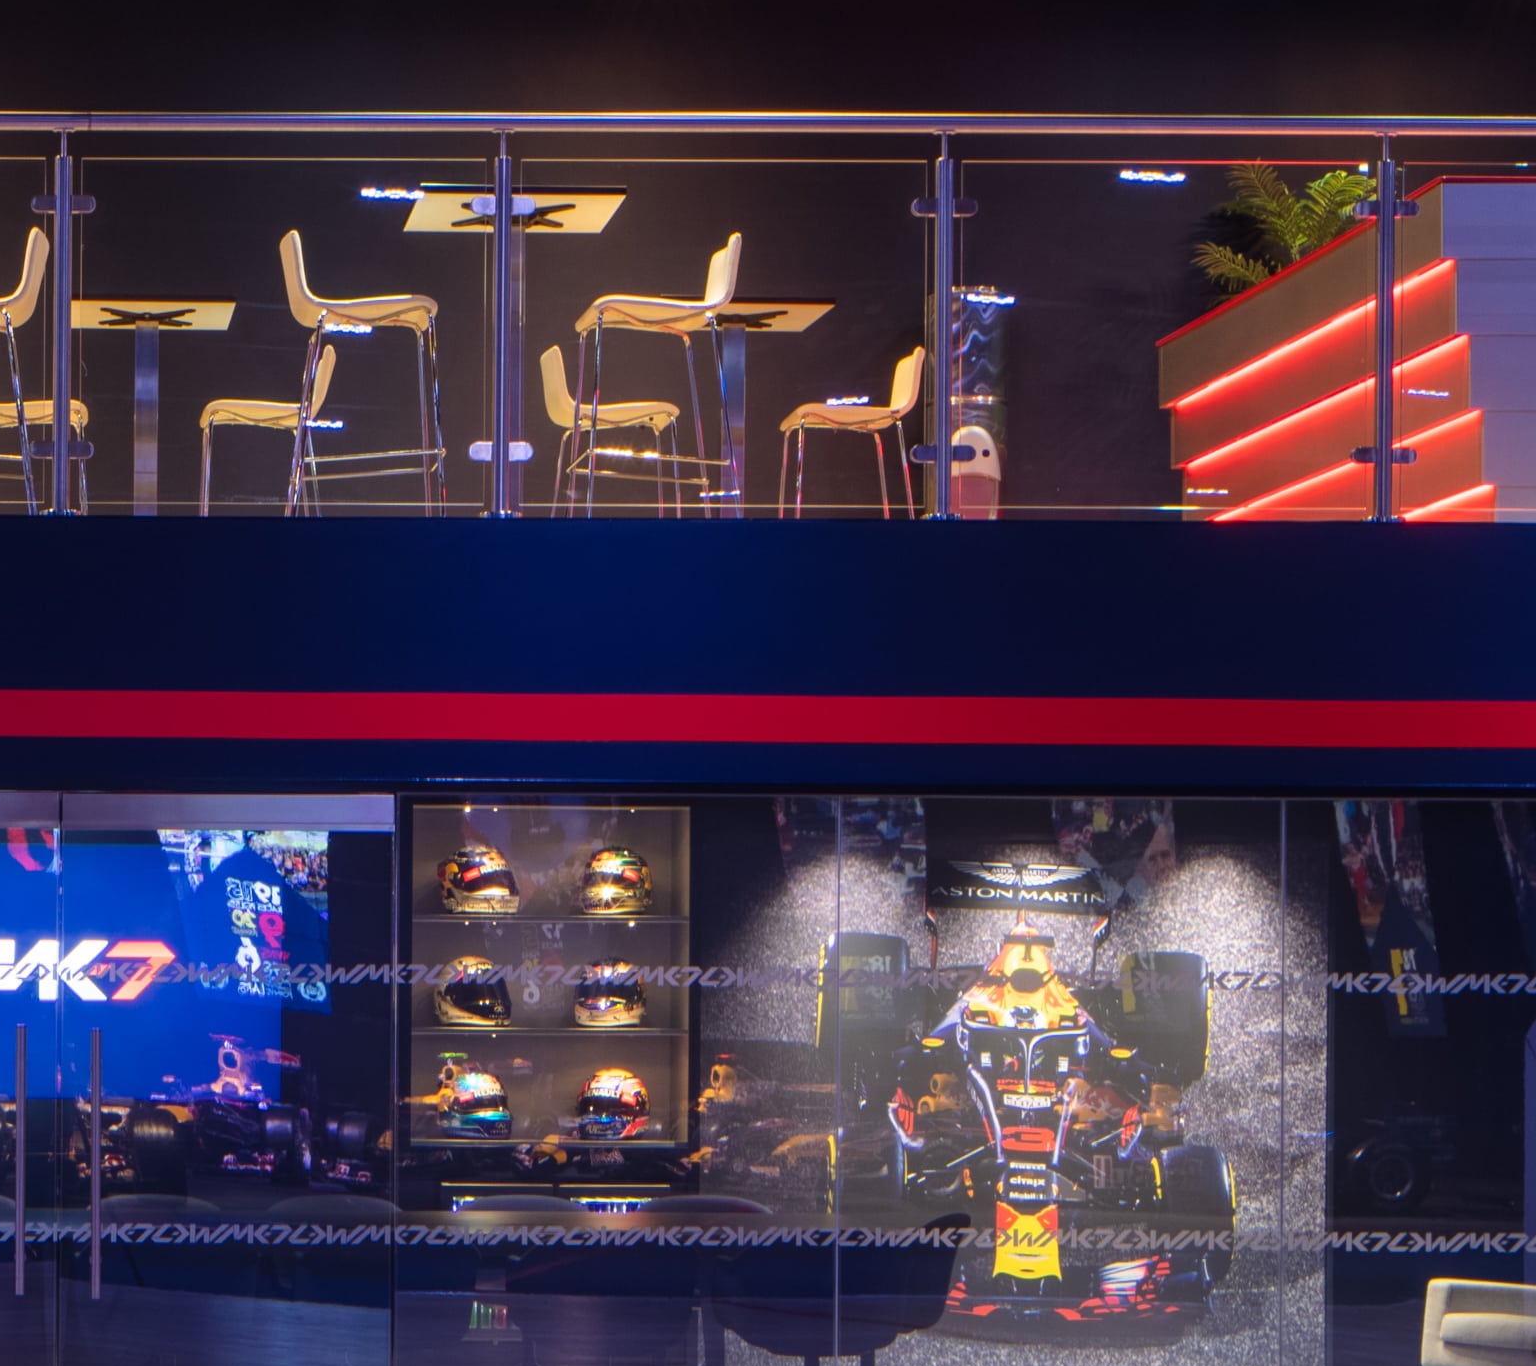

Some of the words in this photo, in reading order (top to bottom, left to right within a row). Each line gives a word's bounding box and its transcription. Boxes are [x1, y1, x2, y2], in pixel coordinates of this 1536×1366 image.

[932, 886, 1013, 899] ASTON
[1019, 889, 1106, 904] MARTIN
[1001, 1126, 1056, 1152] 3
